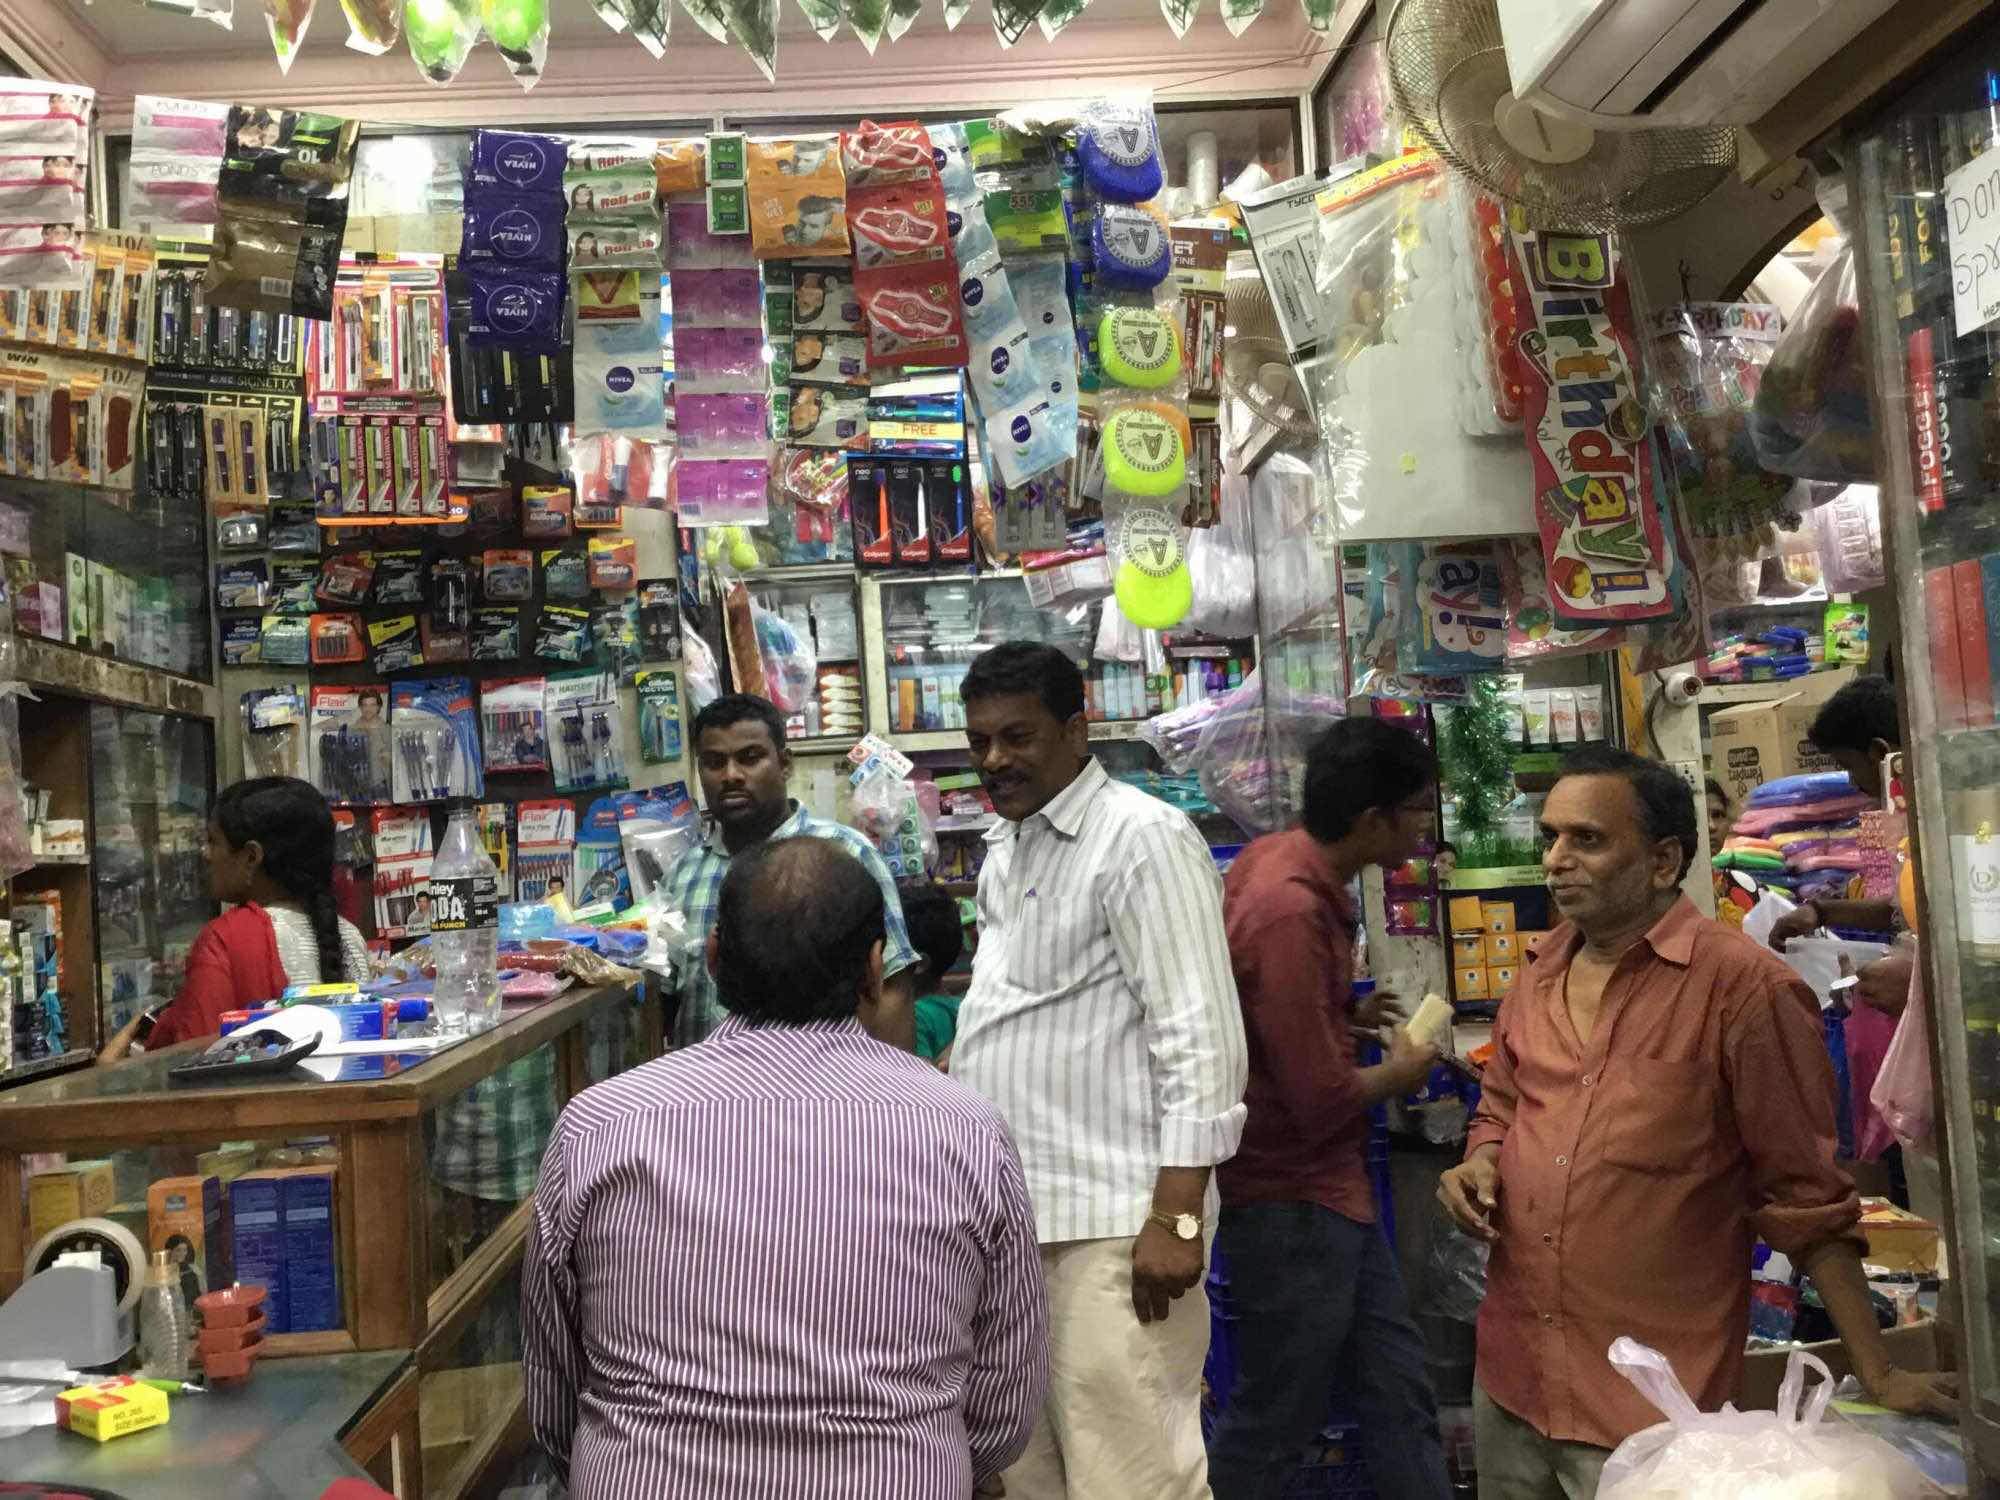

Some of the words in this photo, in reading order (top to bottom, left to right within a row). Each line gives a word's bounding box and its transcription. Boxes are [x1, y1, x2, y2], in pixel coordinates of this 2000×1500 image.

[237, 374, 296, 391] SIGNETTA
[902, 423, 937, 435] FREE
[863, 551, 890, 560] Colgate
[901, 549, 928, 559] Colgate
[319, 695, 348, 707] Flair
